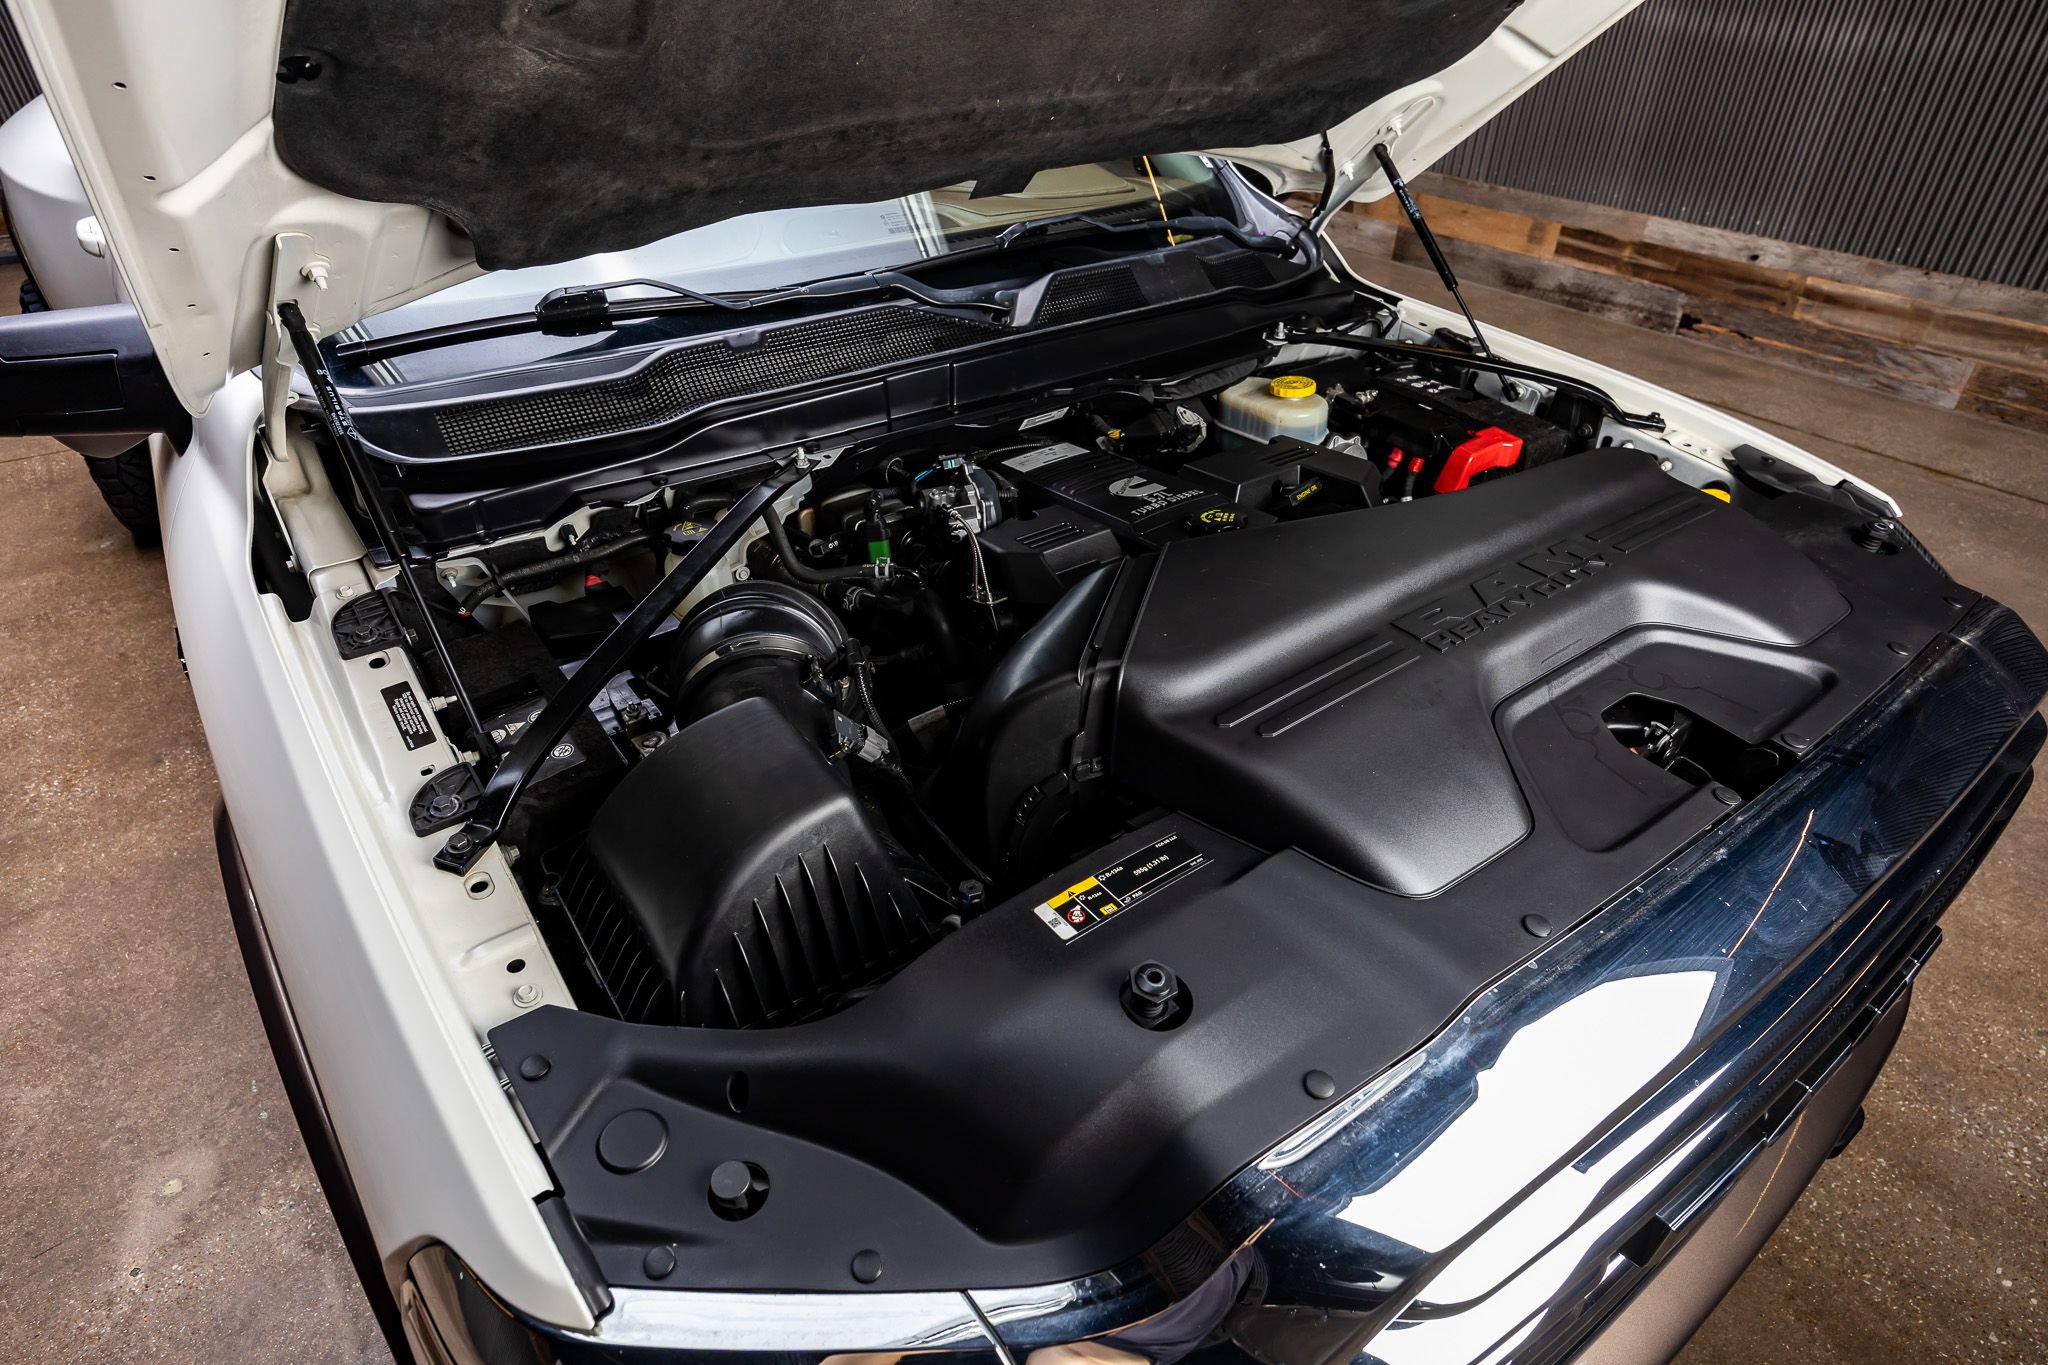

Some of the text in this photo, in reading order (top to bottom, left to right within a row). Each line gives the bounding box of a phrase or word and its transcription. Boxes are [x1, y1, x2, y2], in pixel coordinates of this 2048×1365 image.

[1130, 490, 1204, 516] TURBO DIESEL
[1144, 491, 1174, 502] 6.7L
[1390, 539, 1600, 641] RAM
[1424, 553, 1612, 653] HEAVY DUTY
[1104, 866, 1124, 878] R-134a
